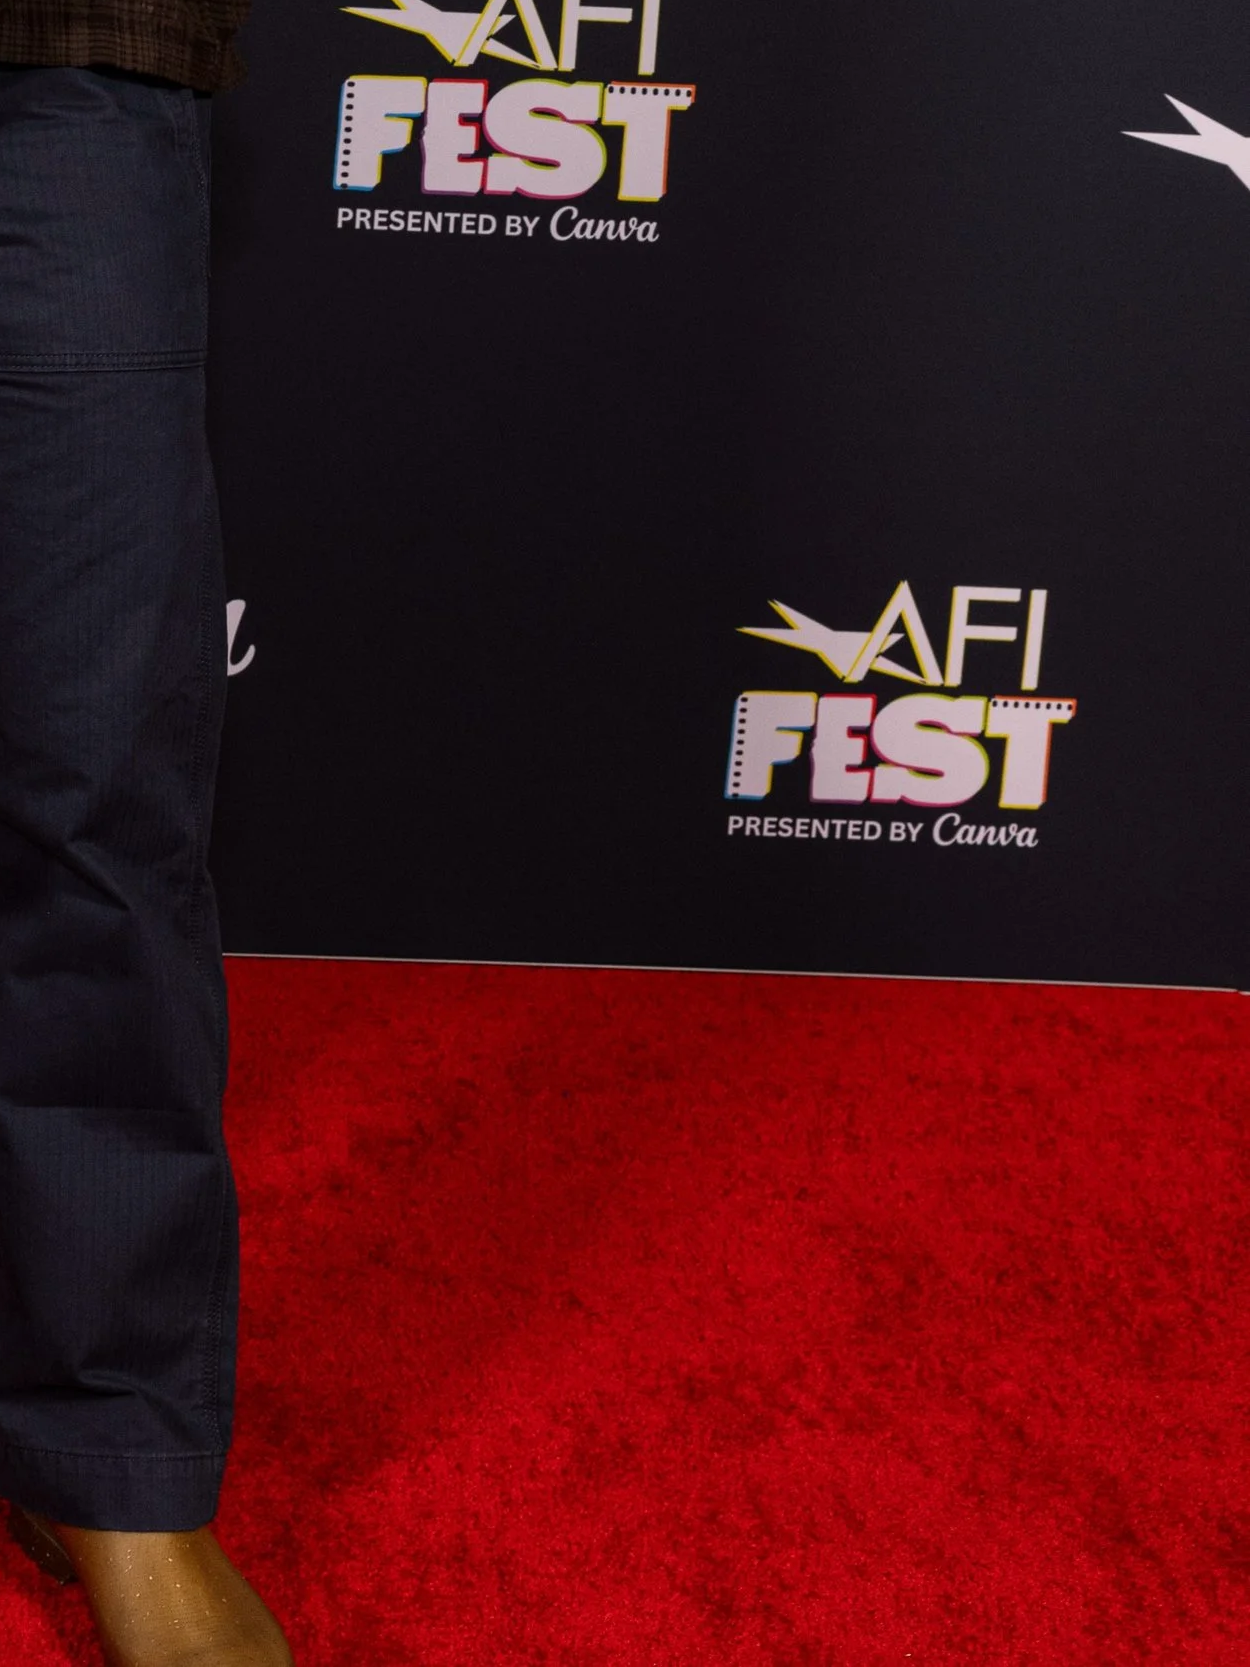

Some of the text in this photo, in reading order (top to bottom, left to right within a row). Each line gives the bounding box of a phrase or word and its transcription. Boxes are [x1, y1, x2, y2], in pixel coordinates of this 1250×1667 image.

[333, 74, 696, 202] FEST
[336, 206, 659, 242] PRESENTED BY Canva
[844, 580, 1047, 691] AFI
[725, 690, 1077, 810] FEST
[727, 812, 1038, 848] PRESENTED BY Canva
